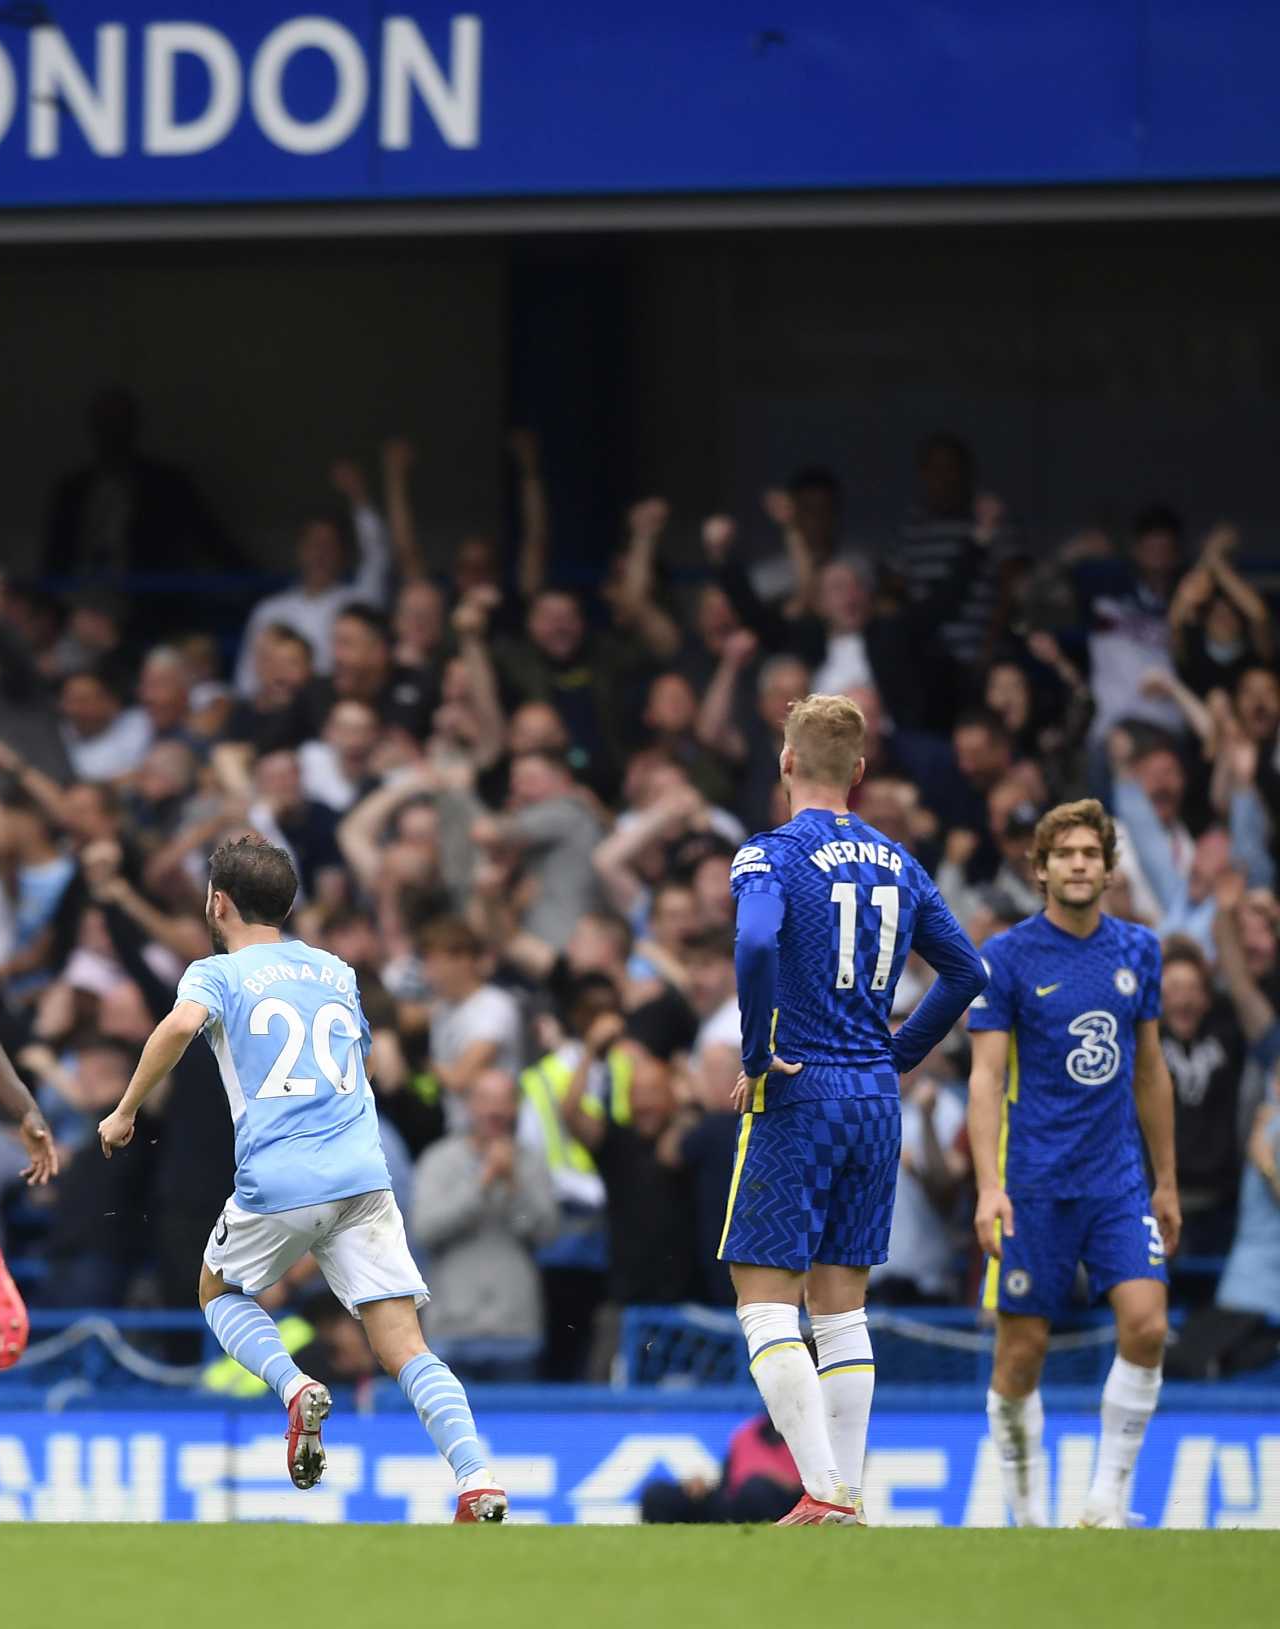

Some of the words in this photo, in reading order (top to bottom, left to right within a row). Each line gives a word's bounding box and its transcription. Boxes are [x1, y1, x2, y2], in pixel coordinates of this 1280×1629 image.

[809, 841, 903, 876] WERNER
[830, 882, 900, 991] 11
[242, 963, 357, 1010] BERNARDO
[249, 997, 362, 1100] 20
[1066, 1010, 1120, 1085] 3
[1142, 1216, 1165, 1255] 3
